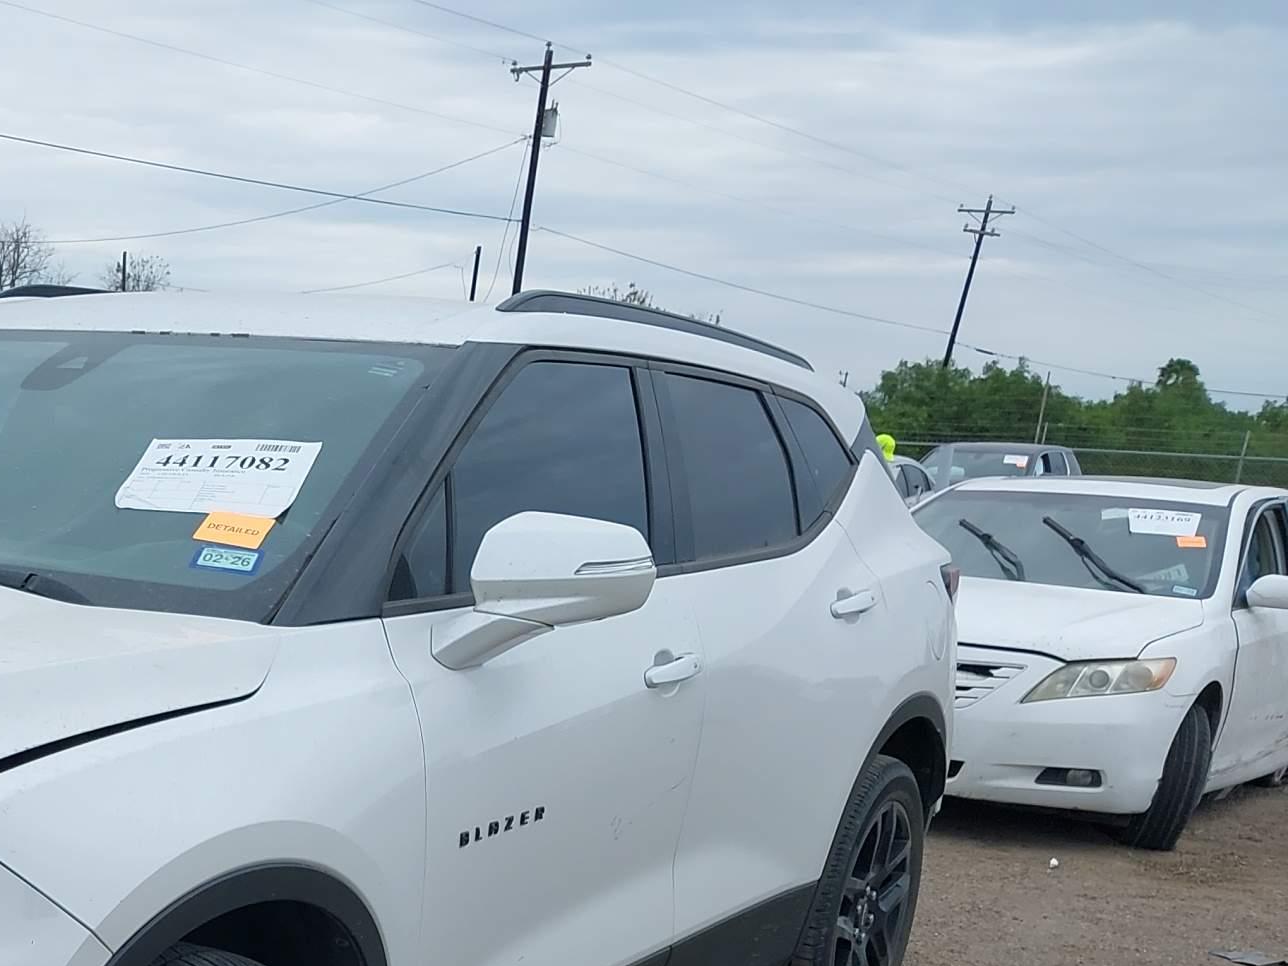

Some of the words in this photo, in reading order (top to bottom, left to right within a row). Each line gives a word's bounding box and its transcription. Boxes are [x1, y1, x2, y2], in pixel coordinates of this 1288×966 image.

[155, 454, 290, 472] 44117082
[207, 522, 260, 537] DETAILED
[459, 806, 545, 848] BLAZER
